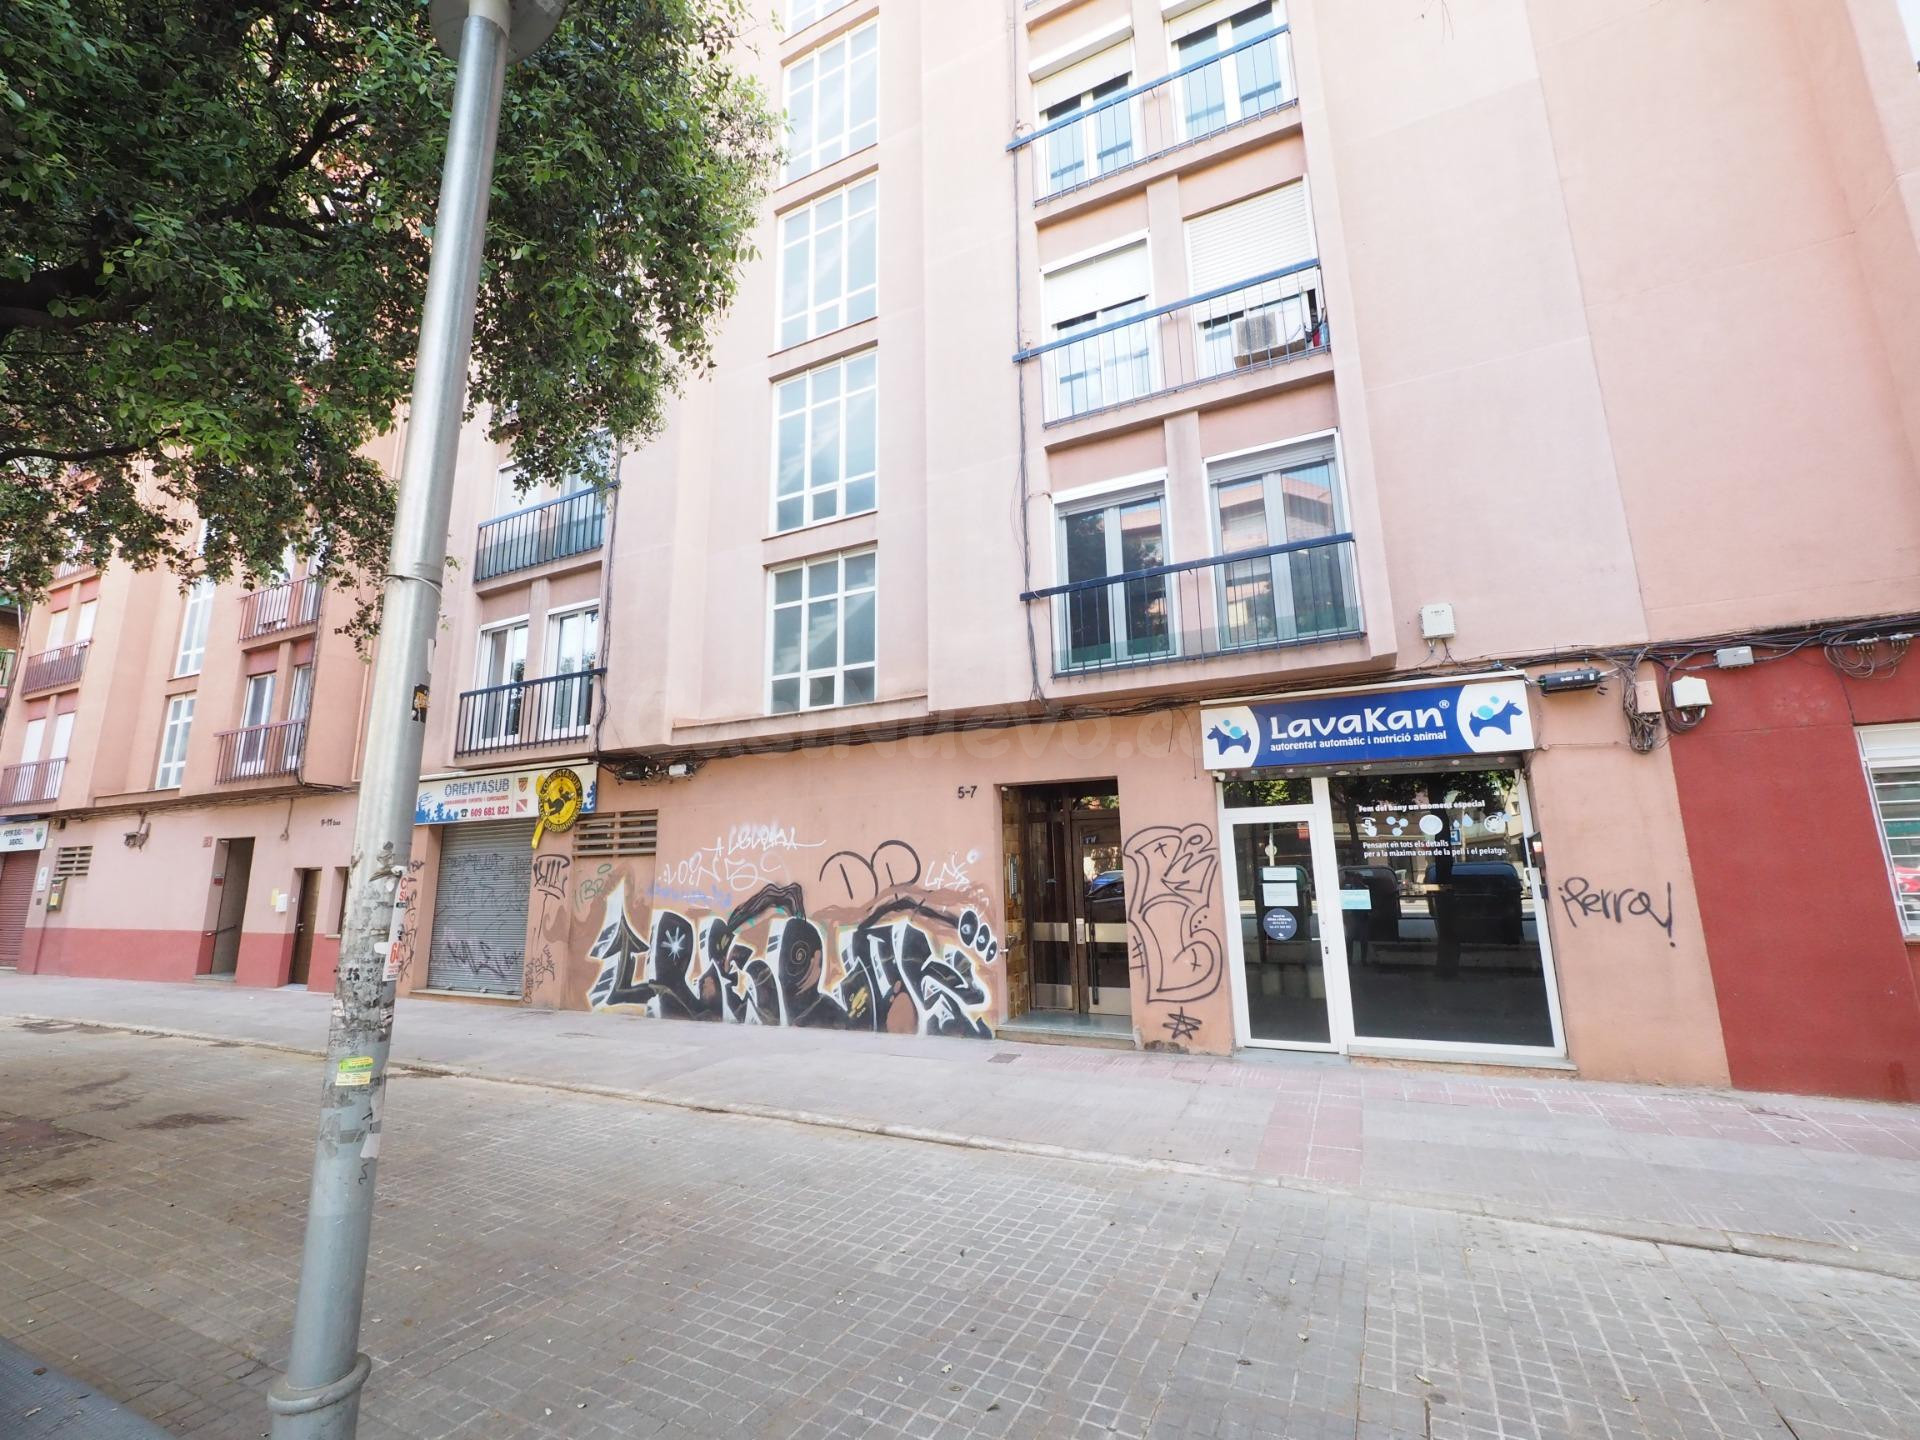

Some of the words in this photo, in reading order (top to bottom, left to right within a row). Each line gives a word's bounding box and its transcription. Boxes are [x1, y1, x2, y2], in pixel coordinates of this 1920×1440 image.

[1270, 740, 1317, 752] autorentat
[1319, 736, 1365, 748] automàtic
[1367, 735, 1371, 745] i
[1373, 732, 1412, 744] nutrició
[1413, 730, 1447, 742] animal
[444, 777, 510, 797] ORIENTASUB
[957, 785, 978, 799] 5-7
[1375, 804, 1388, 812] del
[1388, 804, 1407, 813] bany
[1420, 802, 1452, 810] moment
[1453, 799, 1486, 809] especial
[1363, 851, 1375, 859] per
[1433, 848, 1443, 856] de
[1443, 848, 1451, 856] la
[1470, 846, 1478, 855] el
[1478, 846, 1509, 856] pelatge.
